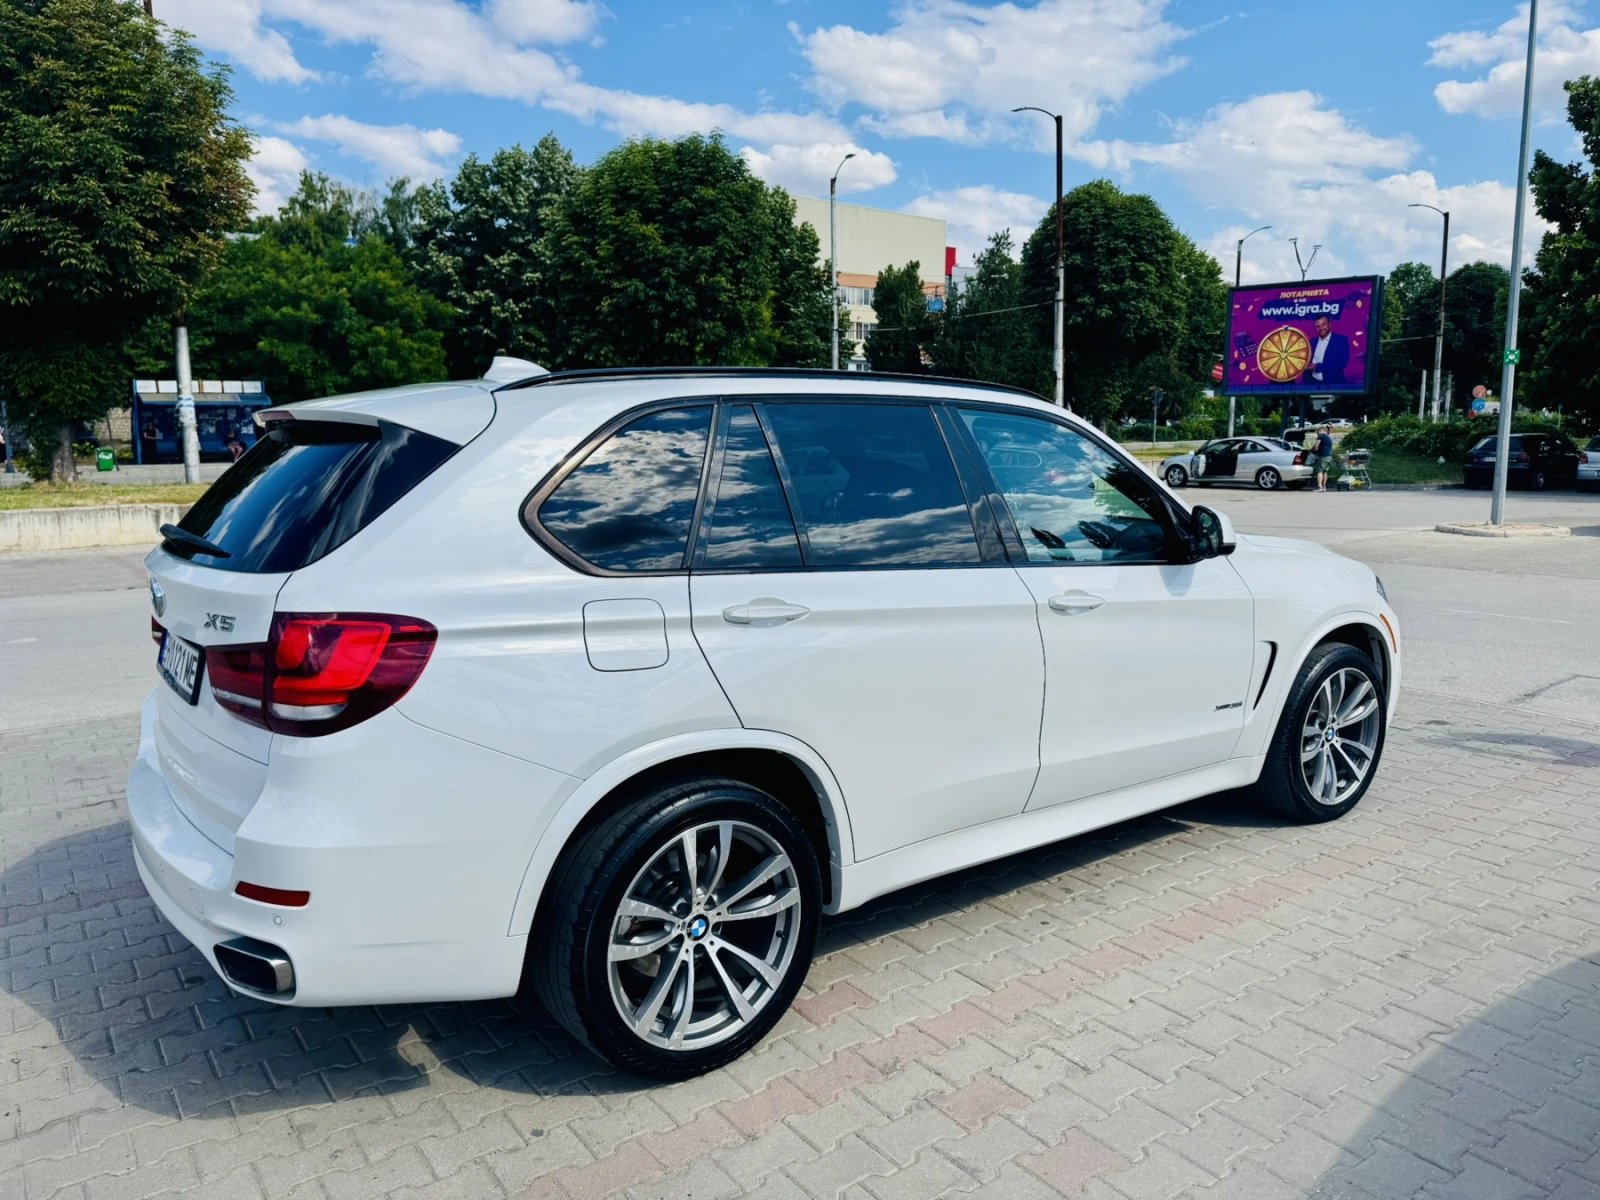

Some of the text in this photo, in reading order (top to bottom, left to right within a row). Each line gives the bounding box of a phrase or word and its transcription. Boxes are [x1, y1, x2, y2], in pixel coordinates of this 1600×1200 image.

[1280, 289, 1329, 298] ЛОТАРИЯТА
[1262, 302, 1339, 316] www.igra.bg
[204, 612, 236, 632] X5
